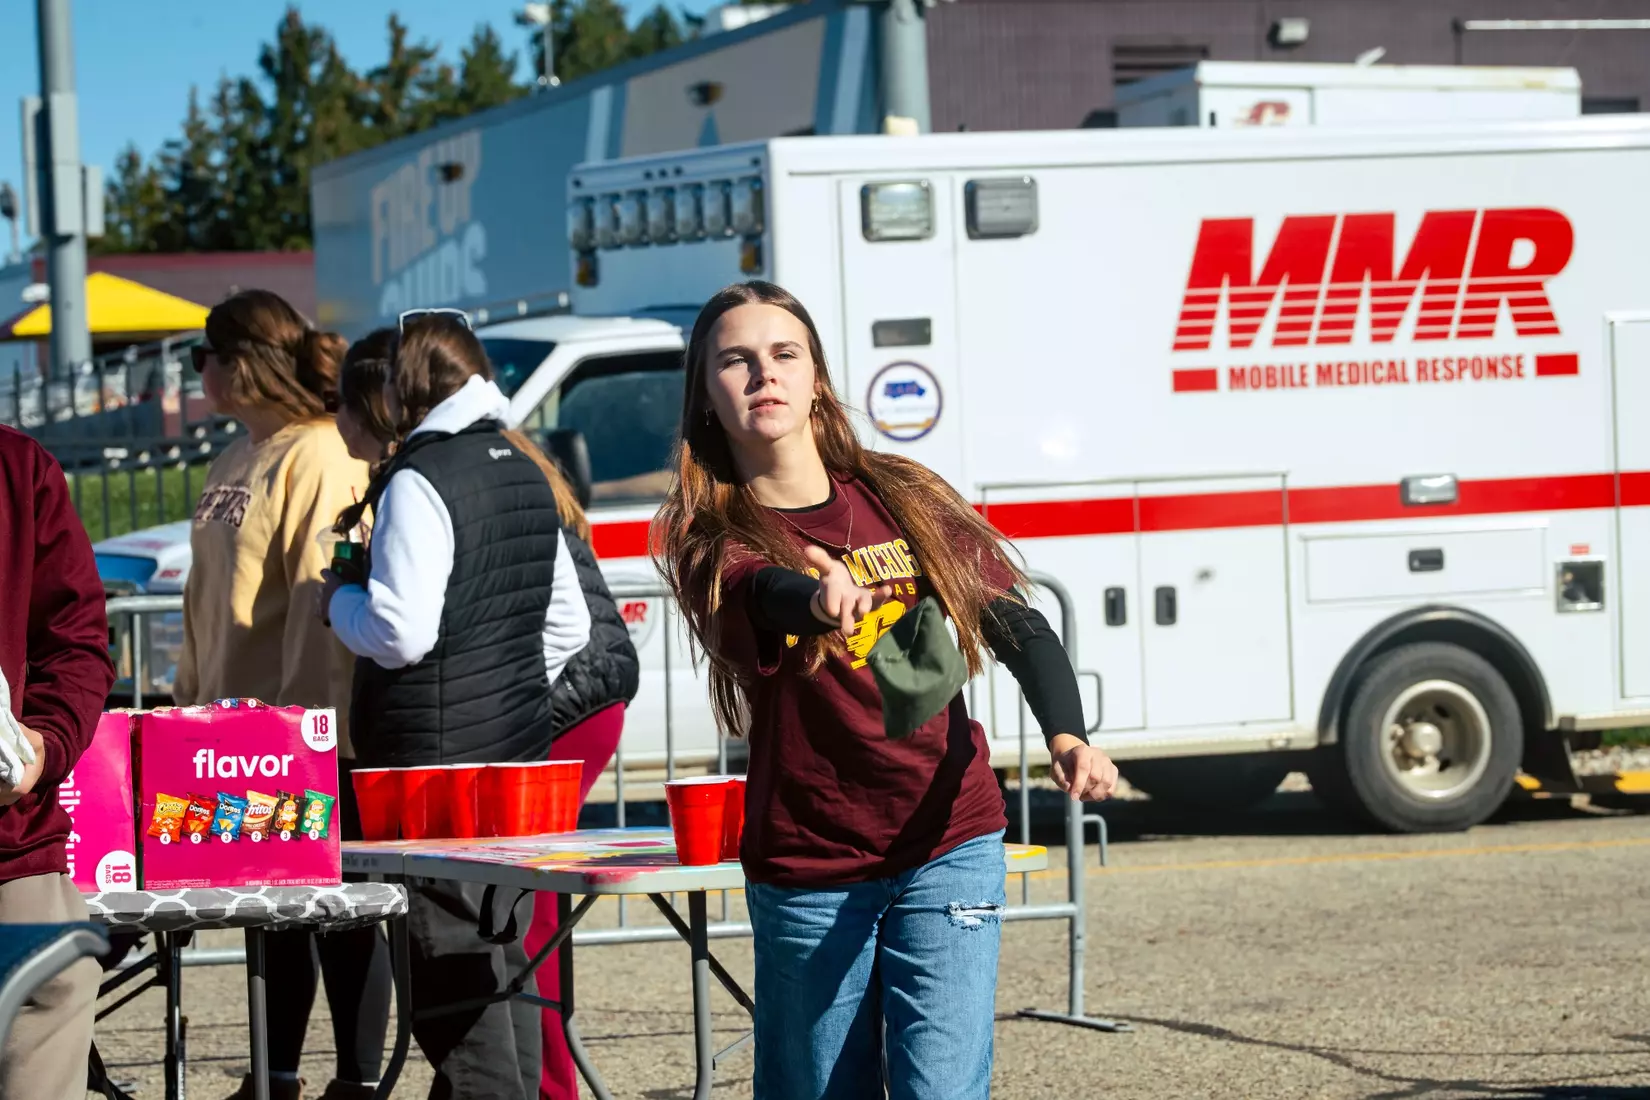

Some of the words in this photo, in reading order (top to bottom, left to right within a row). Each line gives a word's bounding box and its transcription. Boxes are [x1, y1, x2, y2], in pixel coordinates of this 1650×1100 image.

[1172, 206, 1575, 352] MMR
[1228, 364, 1309, 391] MOBILE
[1315, 359, 1410, 387] MEDICAL
[1416, 354, 1525, 384] RESPONSE
[841, 538, 922, 587] MICHIG
[312, 714, 329, 734] 18
[192, 748, 294, 779] flavor
[112, 864, 132, 883] 18
